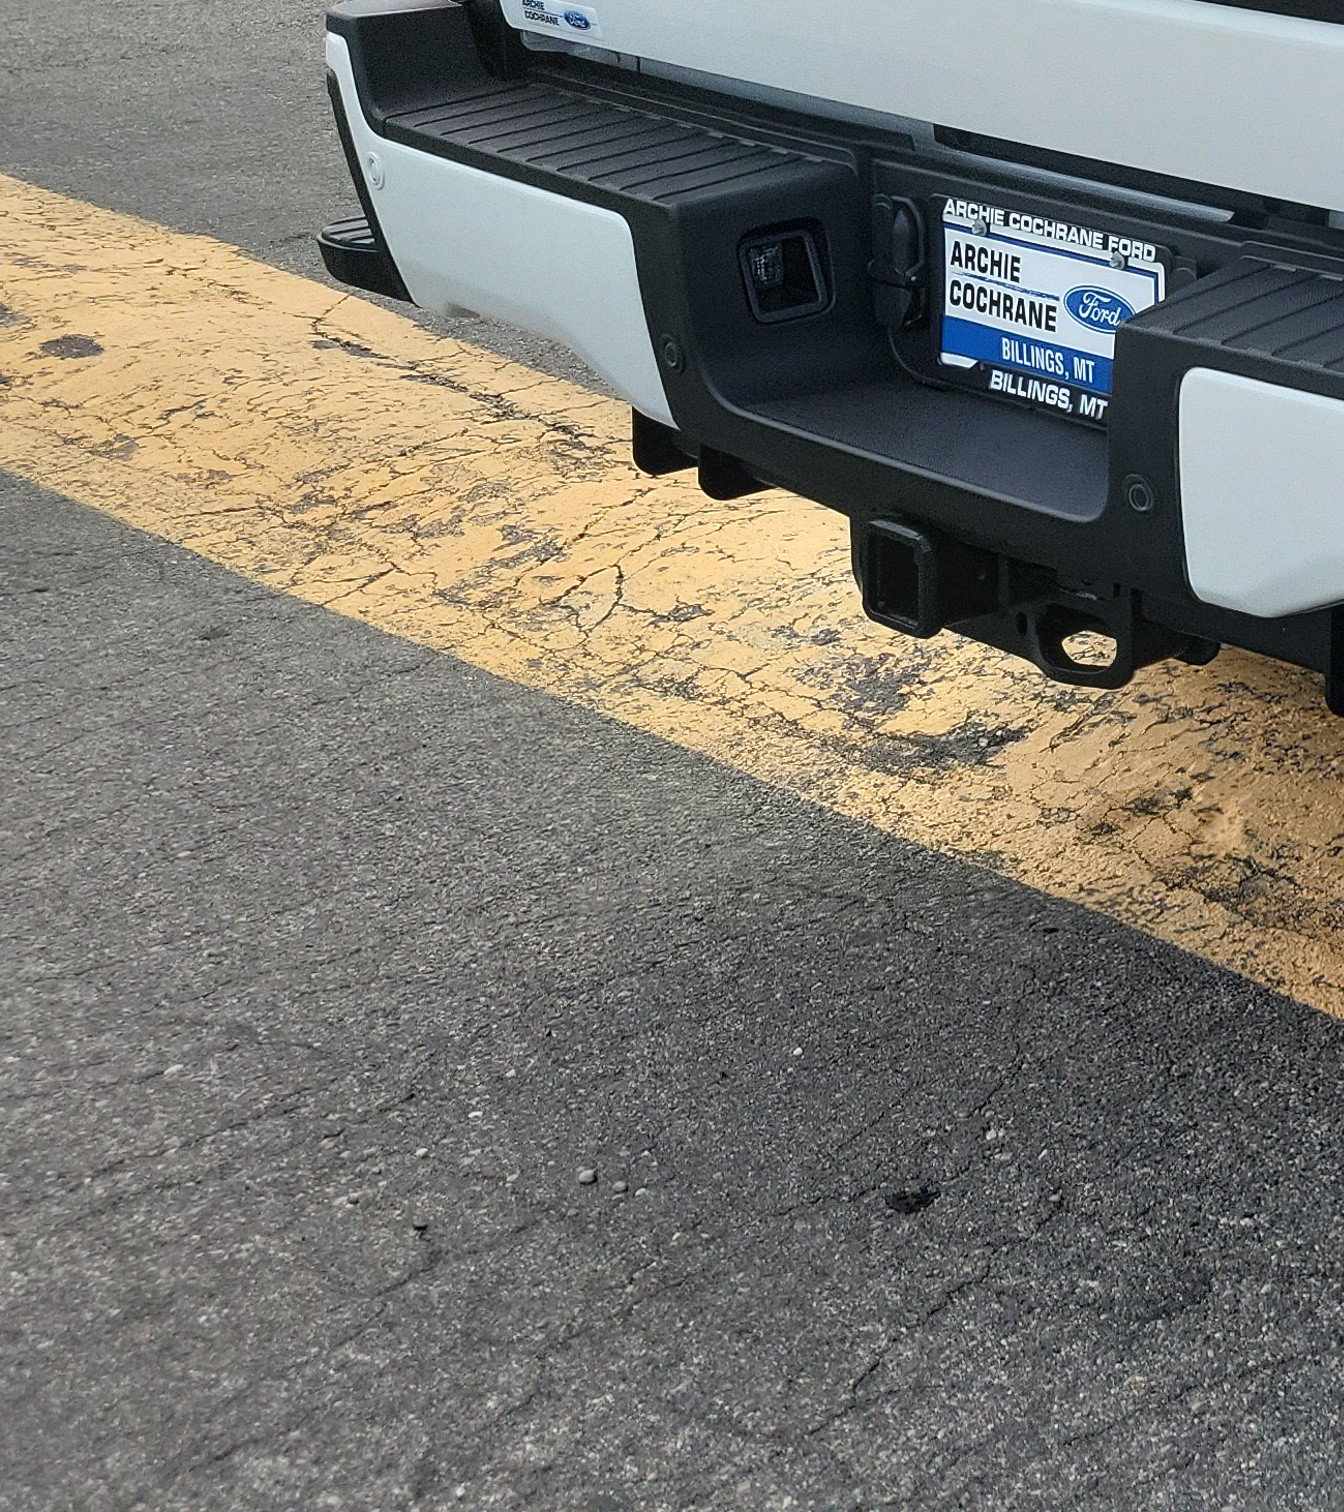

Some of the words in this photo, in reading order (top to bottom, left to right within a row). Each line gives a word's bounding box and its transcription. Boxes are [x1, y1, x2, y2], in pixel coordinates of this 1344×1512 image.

[524, 10, 560, 26] COCHRANE
[943, 199, 1004, 226] ARCHIE
[1009, 213, 1103, 250] COCHRANE
[1108, 238, 1156, 262] FORD
[950, 241, 1021, 283] ARCHIE
[949, 280, 1058, 332] COCHRANE
[1079, 293, 1121, 326] Ford
[1001, 338, 1070, 380] BILLINGS,
[1074, 357, 1095, 383] MT
[990, 369, 1073, 413] BILLINGS,
[1080, 395, 1109, 420] MT
